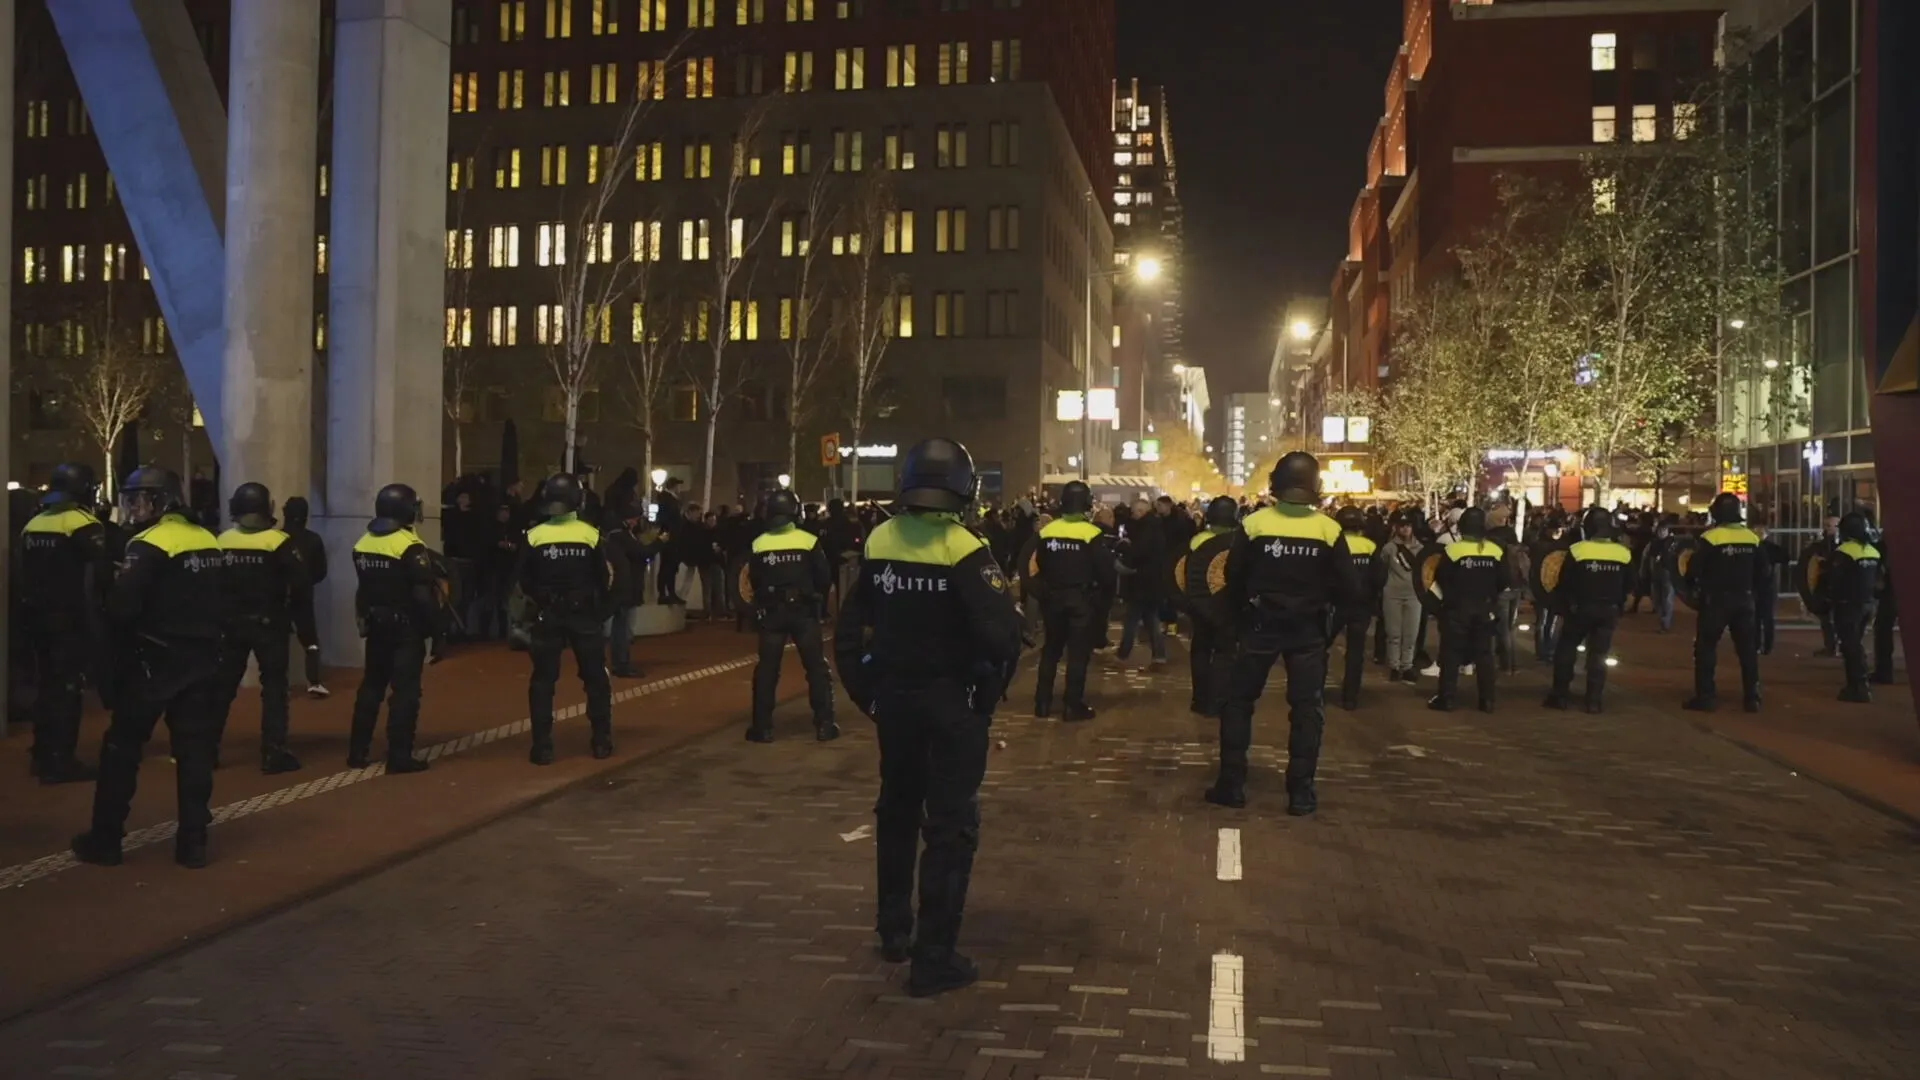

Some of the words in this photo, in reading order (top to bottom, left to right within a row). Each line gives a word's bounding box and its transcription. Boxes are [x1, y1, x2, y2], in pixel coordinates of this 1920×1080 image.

[543, 544, 586, 559] POLITIE
[1047, 538, 1080, 552] POLITIE
[1264, 538, 1318, 558] POLITIE
[763, 552, 802, 566] POLITIE
[1353, 557, 1370, 565] ITIE
[1460, 557, 1494, 569] POLITIE
[1586, 560, 1620, 573] POLITIE
[873, 562, 948, 594] POLITIE
